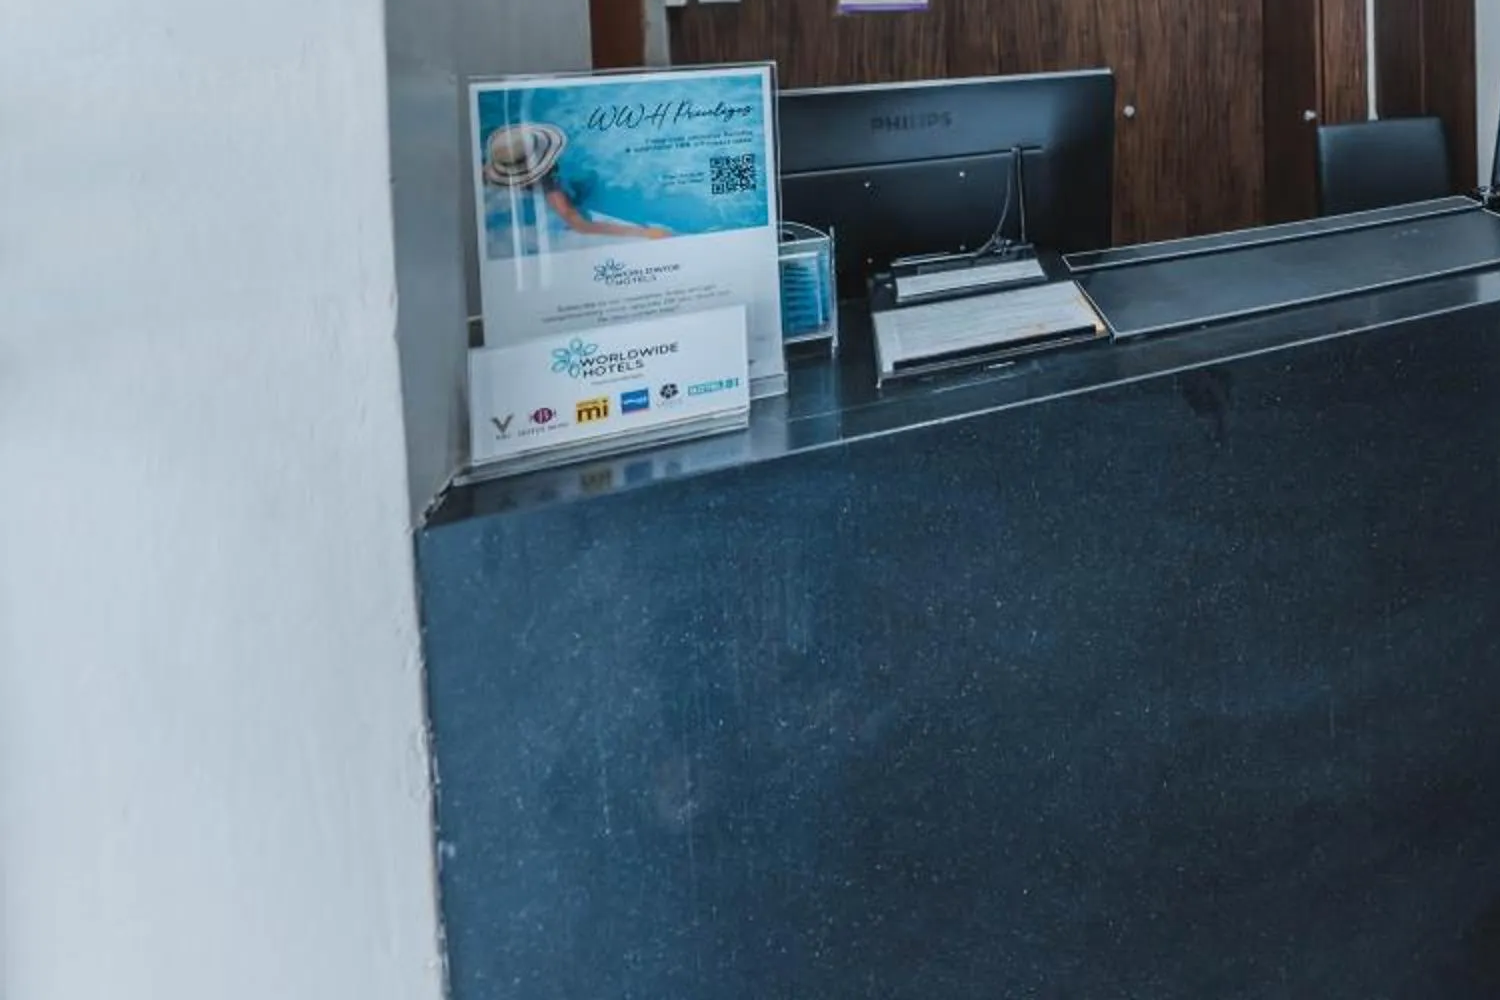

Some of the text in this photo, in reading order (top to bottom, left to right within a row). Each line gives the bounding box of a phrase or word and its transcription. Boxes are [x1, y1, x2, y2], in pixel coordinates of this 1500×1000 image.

[870, 110, 954, 135] PHILIPS
[579, 341, 680, 368] WORLDWIDE
[582, 359, 645, 379] HOTELS
[576, 398, 609, 423] mi
